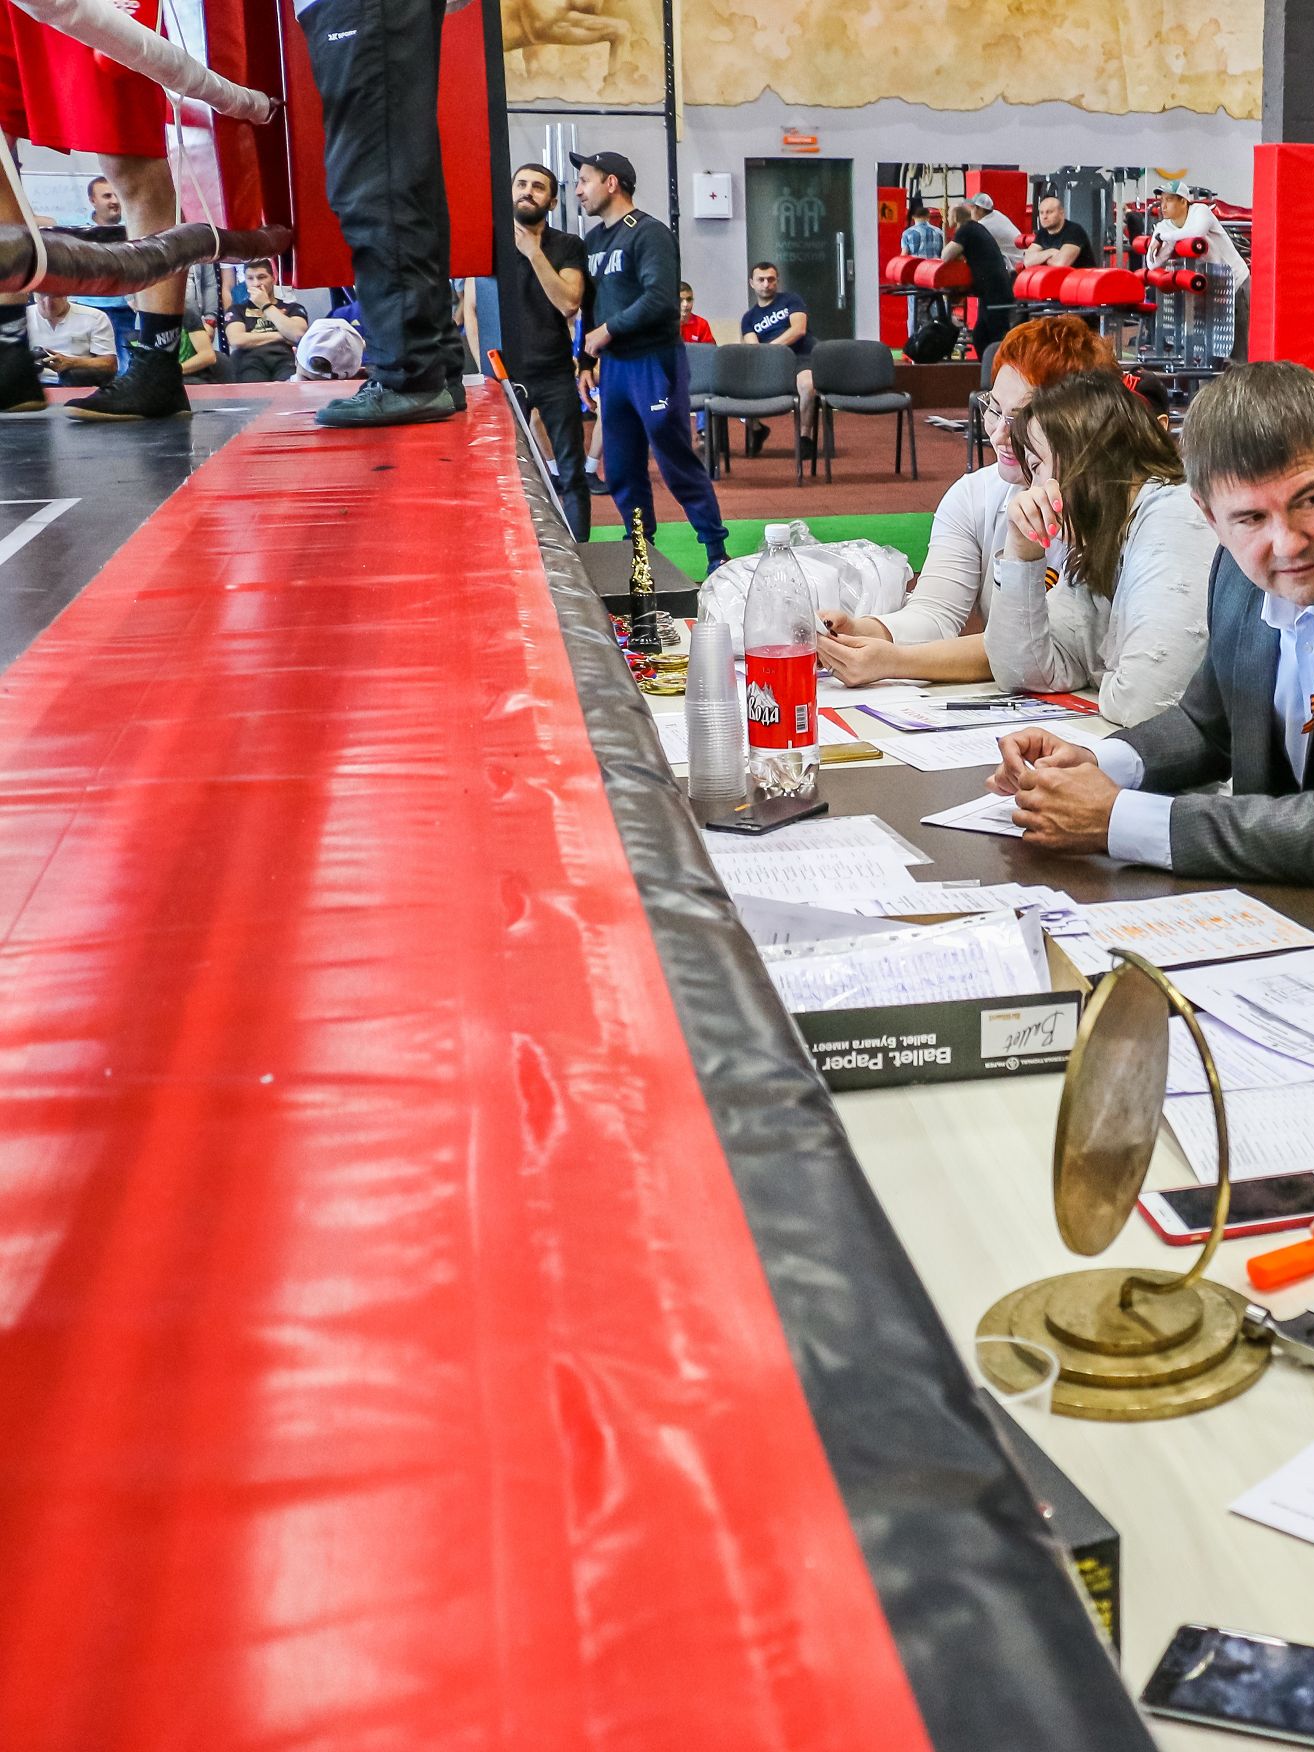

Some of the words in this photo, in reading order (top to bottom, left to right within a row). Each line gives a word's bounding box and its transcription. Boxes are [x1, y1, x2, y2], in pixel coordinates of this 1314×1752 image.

[754, 307, 790, 334] adidas
[1005, 1010, 1065, 1052] Ballet
[812, 1039, 851, 1053] имеет
[852, 1034, 897, 1049] Бумага
[899, 1033, 937, 1047] Ballet.
[821, 1050, 883, 1072] Paper
[888, 1047, 952, 1067] Ballet.
[1020, 1055, 1072, 1066] NTERNATIONAL
